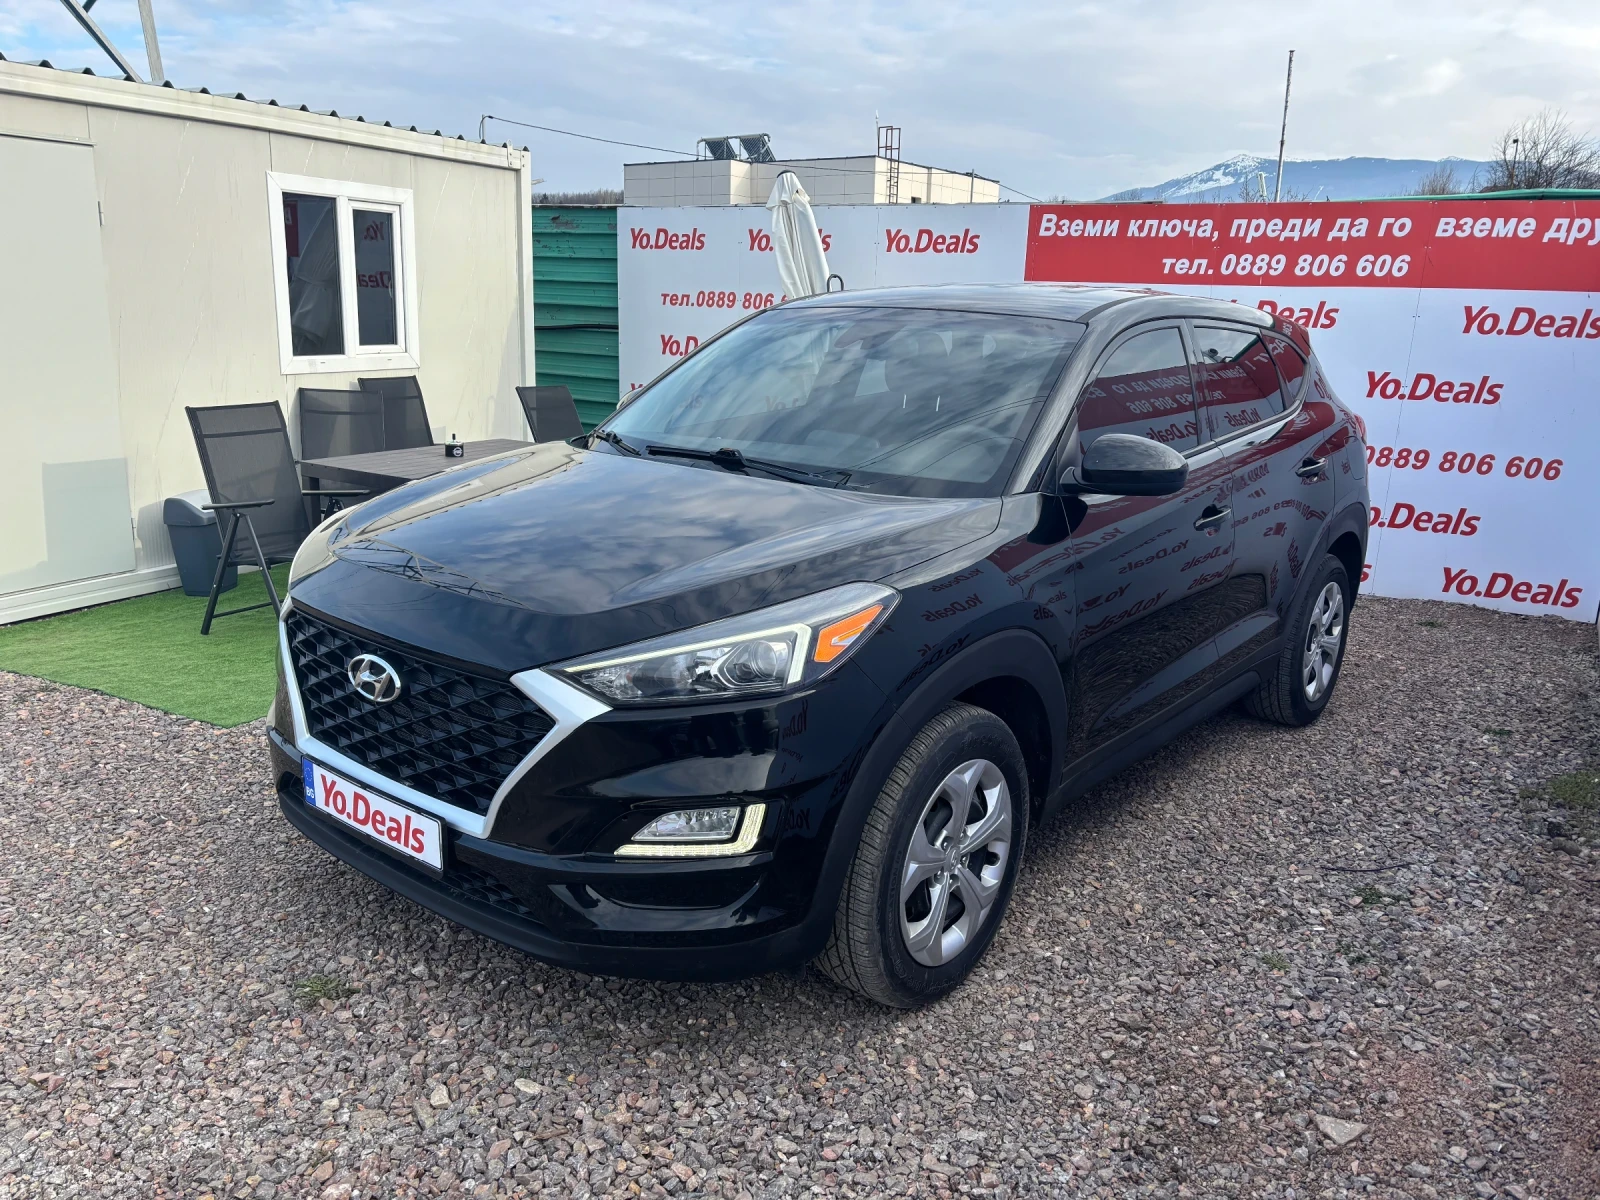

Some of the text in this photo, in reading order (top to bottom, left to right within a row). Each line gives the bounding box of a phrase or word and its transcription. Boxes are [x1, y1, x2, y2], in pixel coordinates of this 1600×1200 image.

[630, 227, 706, 250] Yo.Deals
[885, 228, 981, 254] Yo.Deals
[1038, 213, 1119, 237] Вземи
[1126, 217, 1219, 242] ключа,
[1229, 217, 1322, 243] преди
[1327, 217, 1369, 242] да
[1377, 217, 1412, 237] го
[1435, 217, 1537, 237] вземе
[1161, 253, 1411, 277] тел. 0889 806 606
[742, 292, 775, 309] 806
[1462, 305, 1600, 339] Yo.Deals
[1366, 371, 1504, 404] Yo.Deals
[1438, 451, 1496, 475] 806
[1504, 456, 1564, 481] 606
[1441, 567, 1583, 608] Yo.Deals
[320, 773, 426, 854] Yo.Deals
